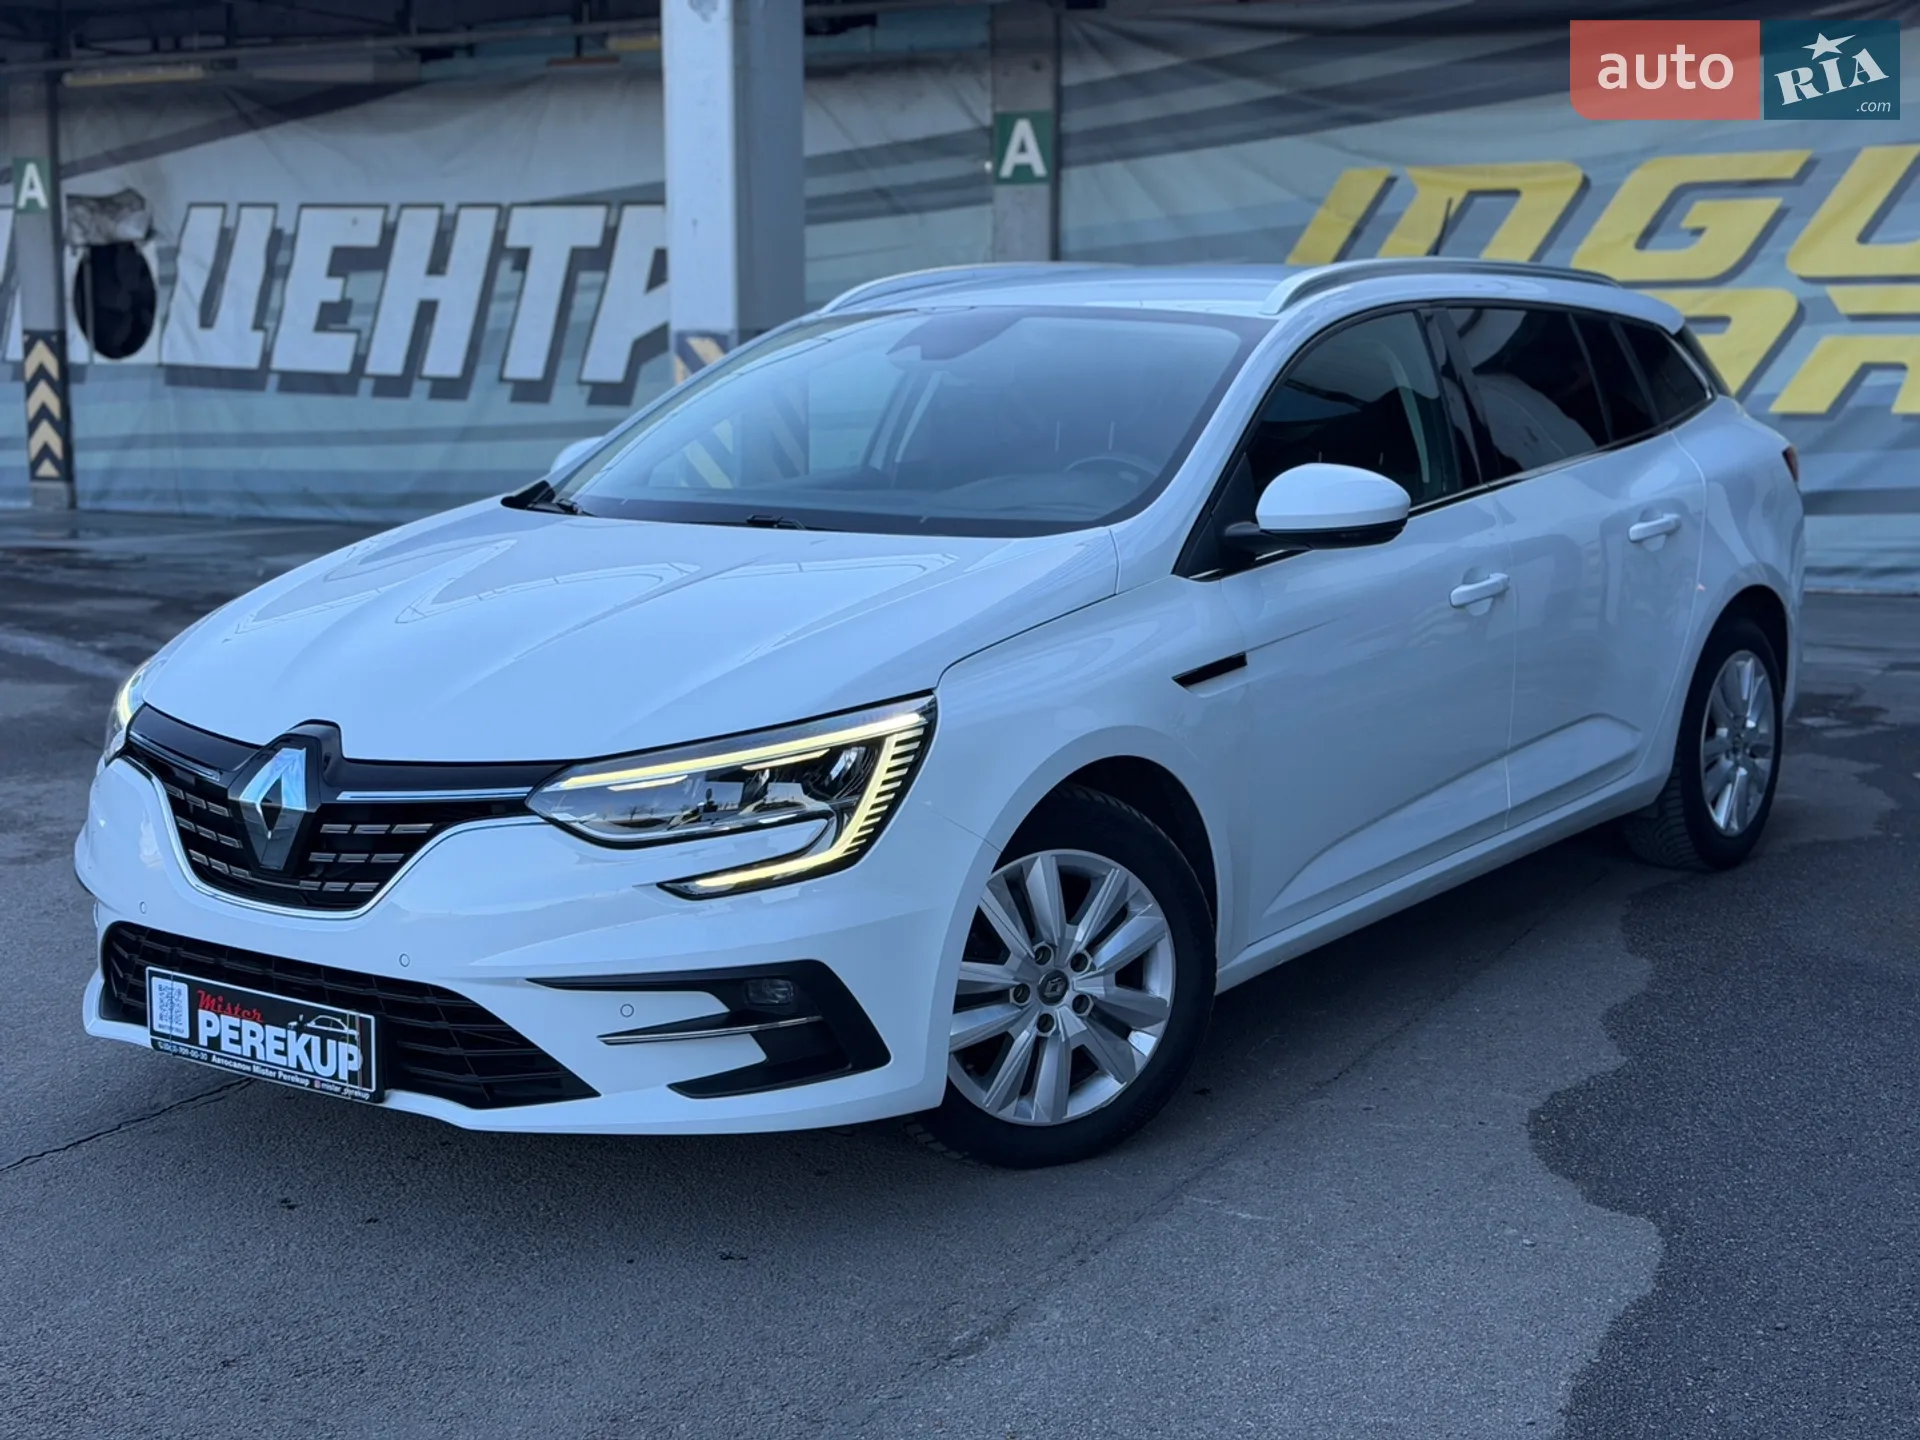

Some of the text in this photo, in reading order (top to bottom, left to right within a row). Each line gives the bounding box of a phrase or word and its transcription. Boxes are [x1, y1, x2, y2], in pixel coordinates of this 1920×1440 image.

[998, 118, 1048, 179] A
[17, 163, 48, 210] A
[197, 990, 264, 1024] Mister
[198, 1009, 363, 1080] PEREKUP
[252, 1064, 276, 1079] Mister
[278, 1070, 310, 1087] Perekup
